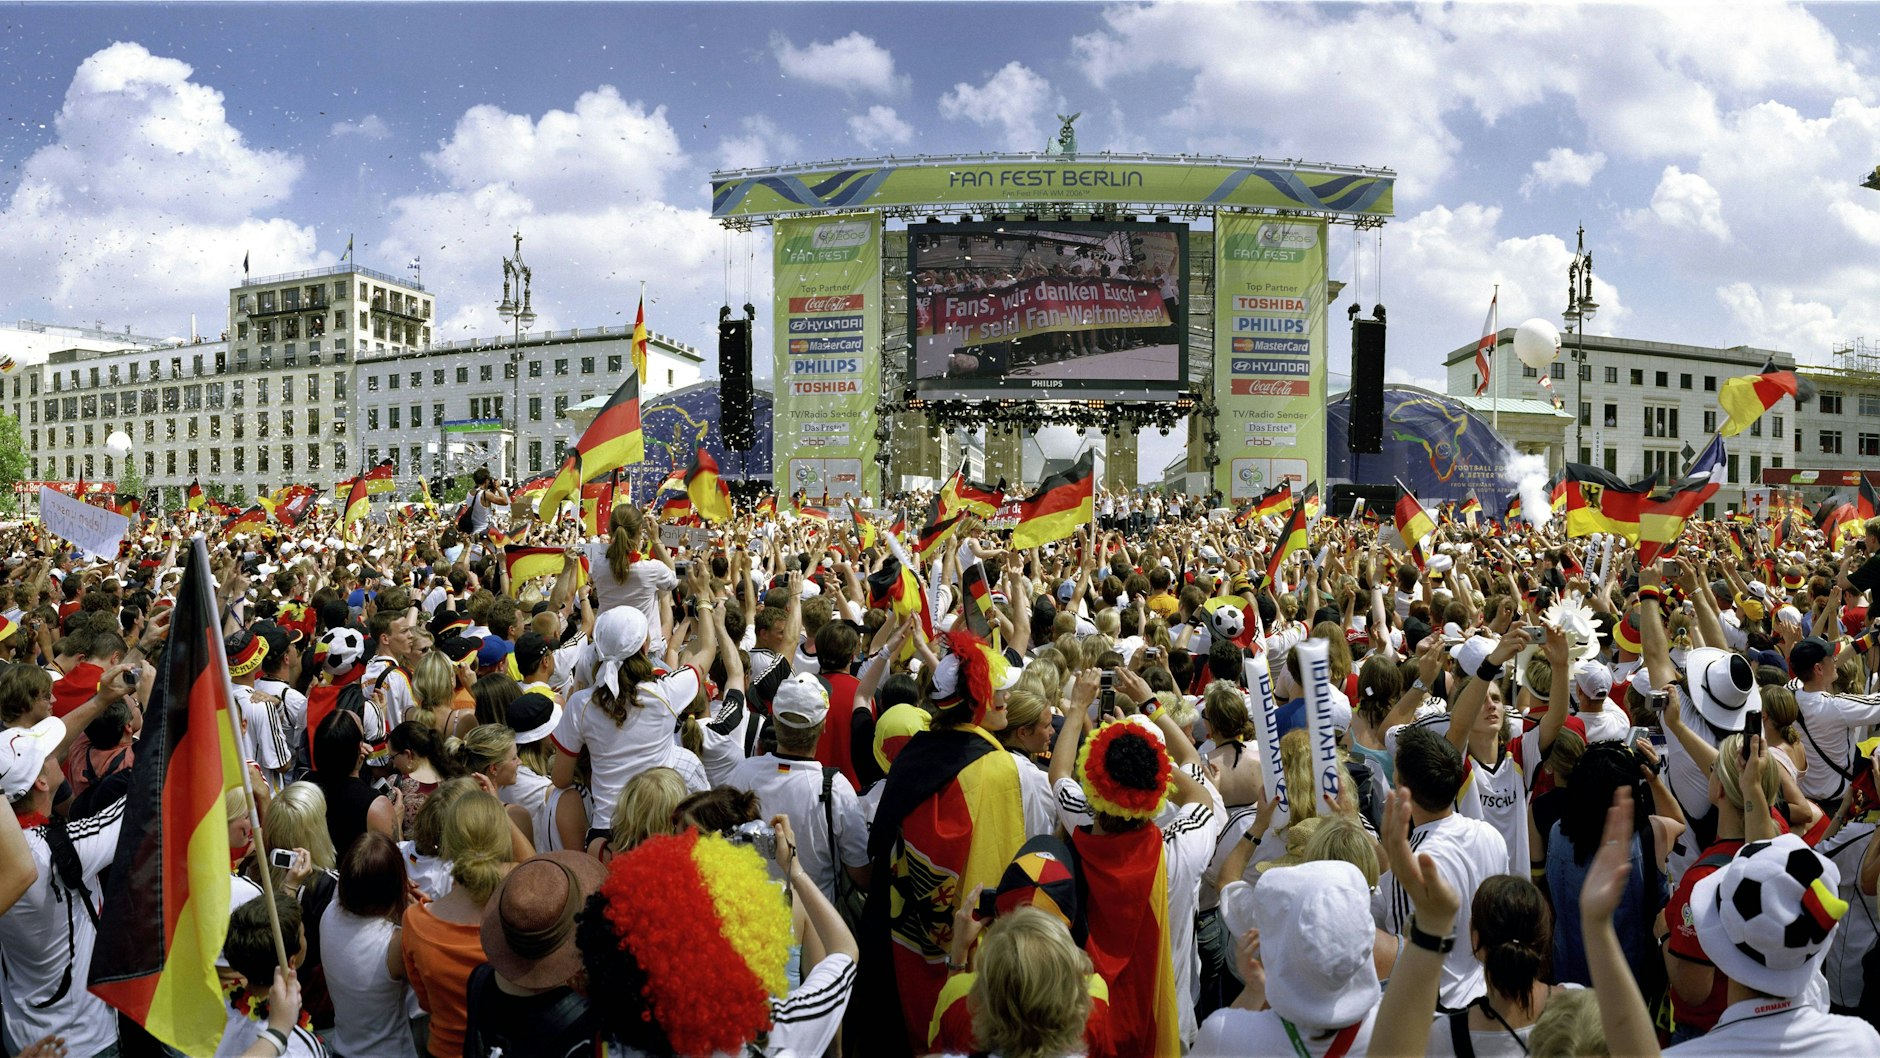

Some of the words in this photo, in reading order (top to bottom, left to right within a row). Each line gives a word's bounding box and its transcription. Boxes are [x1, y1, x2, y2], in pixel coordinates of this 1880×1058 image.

[950, 171, 993, 188] FAN
[1000, 170, 1056, 187] FEST
[1063, 170, 1143, 187] BERLIN
[790, 250, 815, 262] FAN
[818, 250, 850, 260] FEST
[1233, 249, 1260, 259] FAN
[1264, 250, 1296, 261] FEST
[801, 285, 817, 294] Top
[819, 284, 850, 292] Partner
[1246, 282, 1262, 292] Top
[1265, 283, 1298, 293] Partner
[805, 296, 850, 311] Coca-Cola
[945, 297, 996, 318] Fans,
[1001, 287, 1029, 311] wir
[1035, 280, 1098, 301] danken
[1102, 282, 1136, 303] Euch
[1238, 297, 1305, 311] TOSHIBA
[807, 319, 862, 334] HYUNDAI
[980, 311, 1020, 339] seid
[1239, 317, 1304, 333] PHILIPS
[809, 339, 862, 351] MasterCard
[1255, 340, 1308, 352] MasterCard
[795, 359, 857, 374] PHILIPS
[1252, 361, 1308, 373] HYUNDAI
[795, 381, 857, 393] TOSHIBA
[1031, 379, 1063, 388] PHILIPS
[1248, 380, 1293, 395] Coca-Cola
[790, 410, 828, 420] TV/Radio
[831, 409, 861, 419] Sender
[1232, 410, 1275, 419] TV/Radio
[1277, 411, 1308, 420] Sender
[804, 424, 819, 432] Das
[1249, 423, 1265, 432] Das
[1267, 423, 1289, 432] Erste
[1310, 660, 1335, 761] HYUNDAI
[1259, 673, 1284, 775] HYUNDAI
[1754, 1000, 1792, 1015] GERMANY
